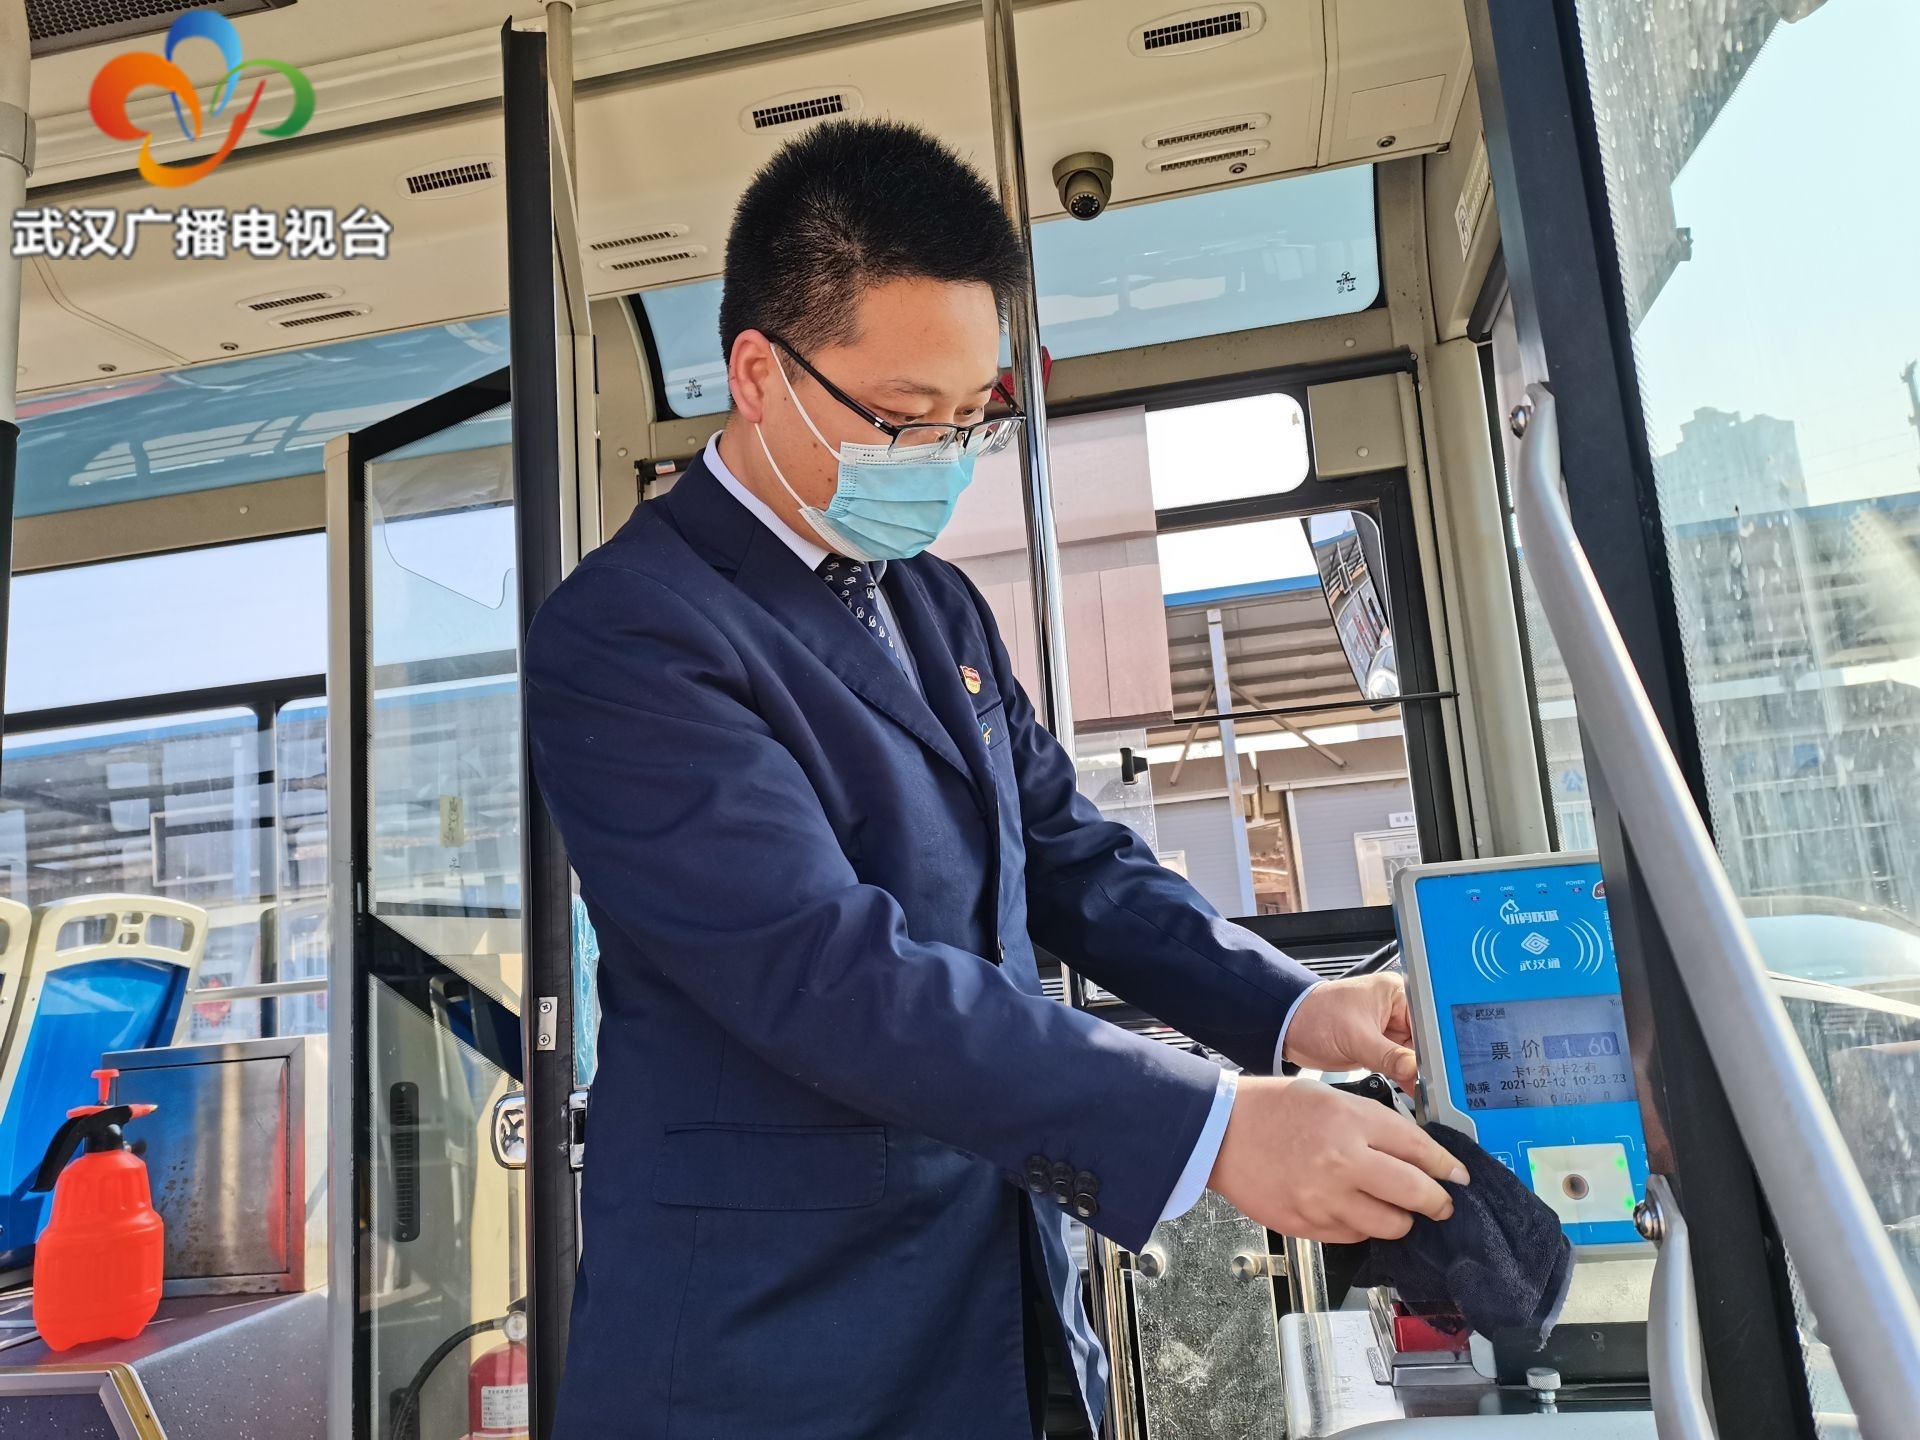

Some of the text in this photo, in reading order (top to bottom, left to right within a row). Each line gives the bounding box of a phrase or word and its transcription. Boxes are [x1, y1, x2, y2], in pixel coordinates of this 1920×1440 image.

[1519, 957, 1561, 972] 武汉通
[1561, 1036, 1613, 1057] 1.60
[1500, 1077, 1566, 1091] 2021-02-13
